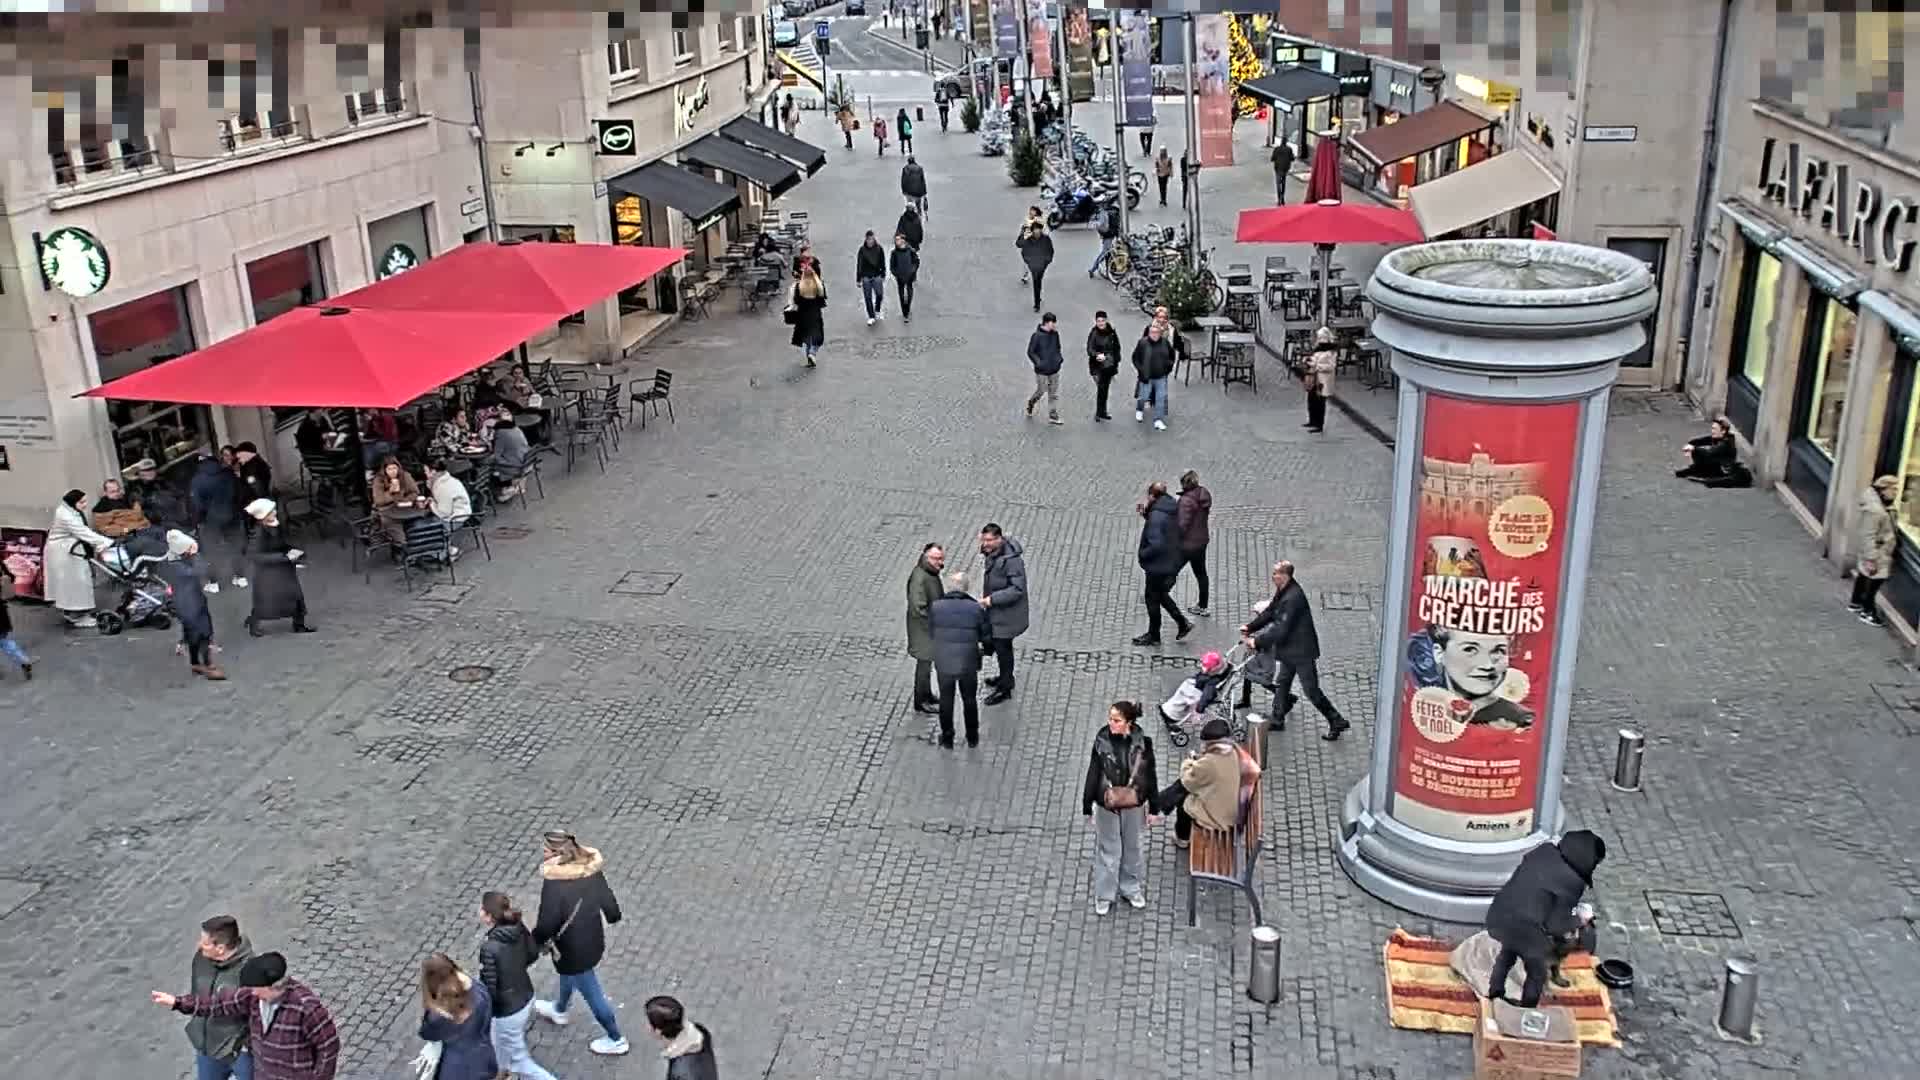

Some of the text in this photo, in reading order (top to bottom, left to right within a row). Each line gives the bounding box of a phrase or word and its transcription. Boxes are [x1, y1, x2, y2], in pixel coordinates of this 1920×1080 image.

[1506, 535, 1536, 544] VILLE
[1423, 574, 1545, 608] MARCHÉ DES
[1418, 594, 1546, 635] CRÉATEURS
[1466, 820, 1511, 832] Amiens
